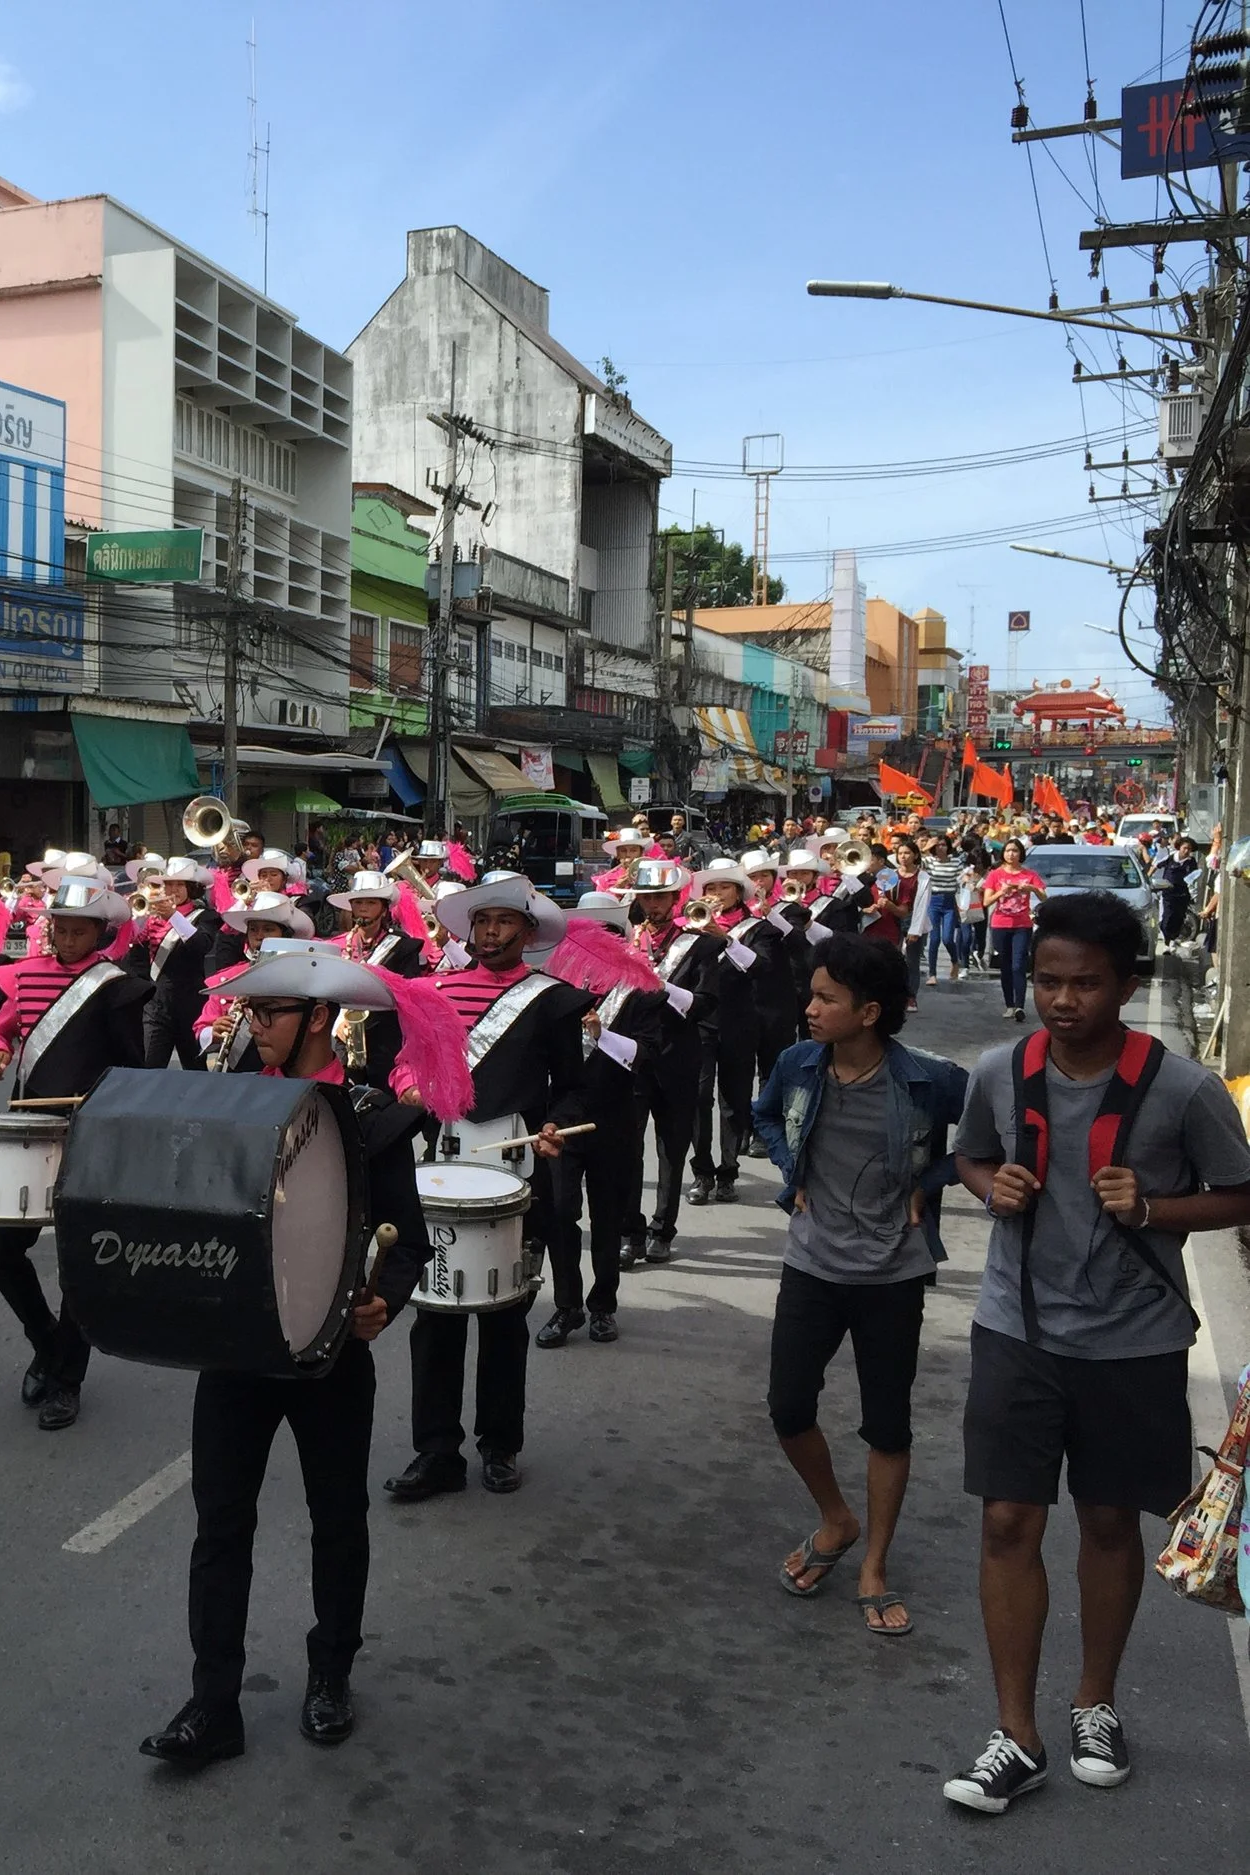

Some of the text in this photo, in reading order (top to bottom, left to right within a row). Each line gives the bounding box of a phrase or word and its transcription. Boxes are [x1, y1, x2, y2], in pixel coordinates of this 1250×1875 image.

[13, 663, 72, 684] OPTICAL
[279, 1103, 320, 1189] ynasty
[91, 1231, 239, 1280] Dynasty
[199, 1270, 220, 1278] USA
[432, 1226, 457, 1298] Dynasty
